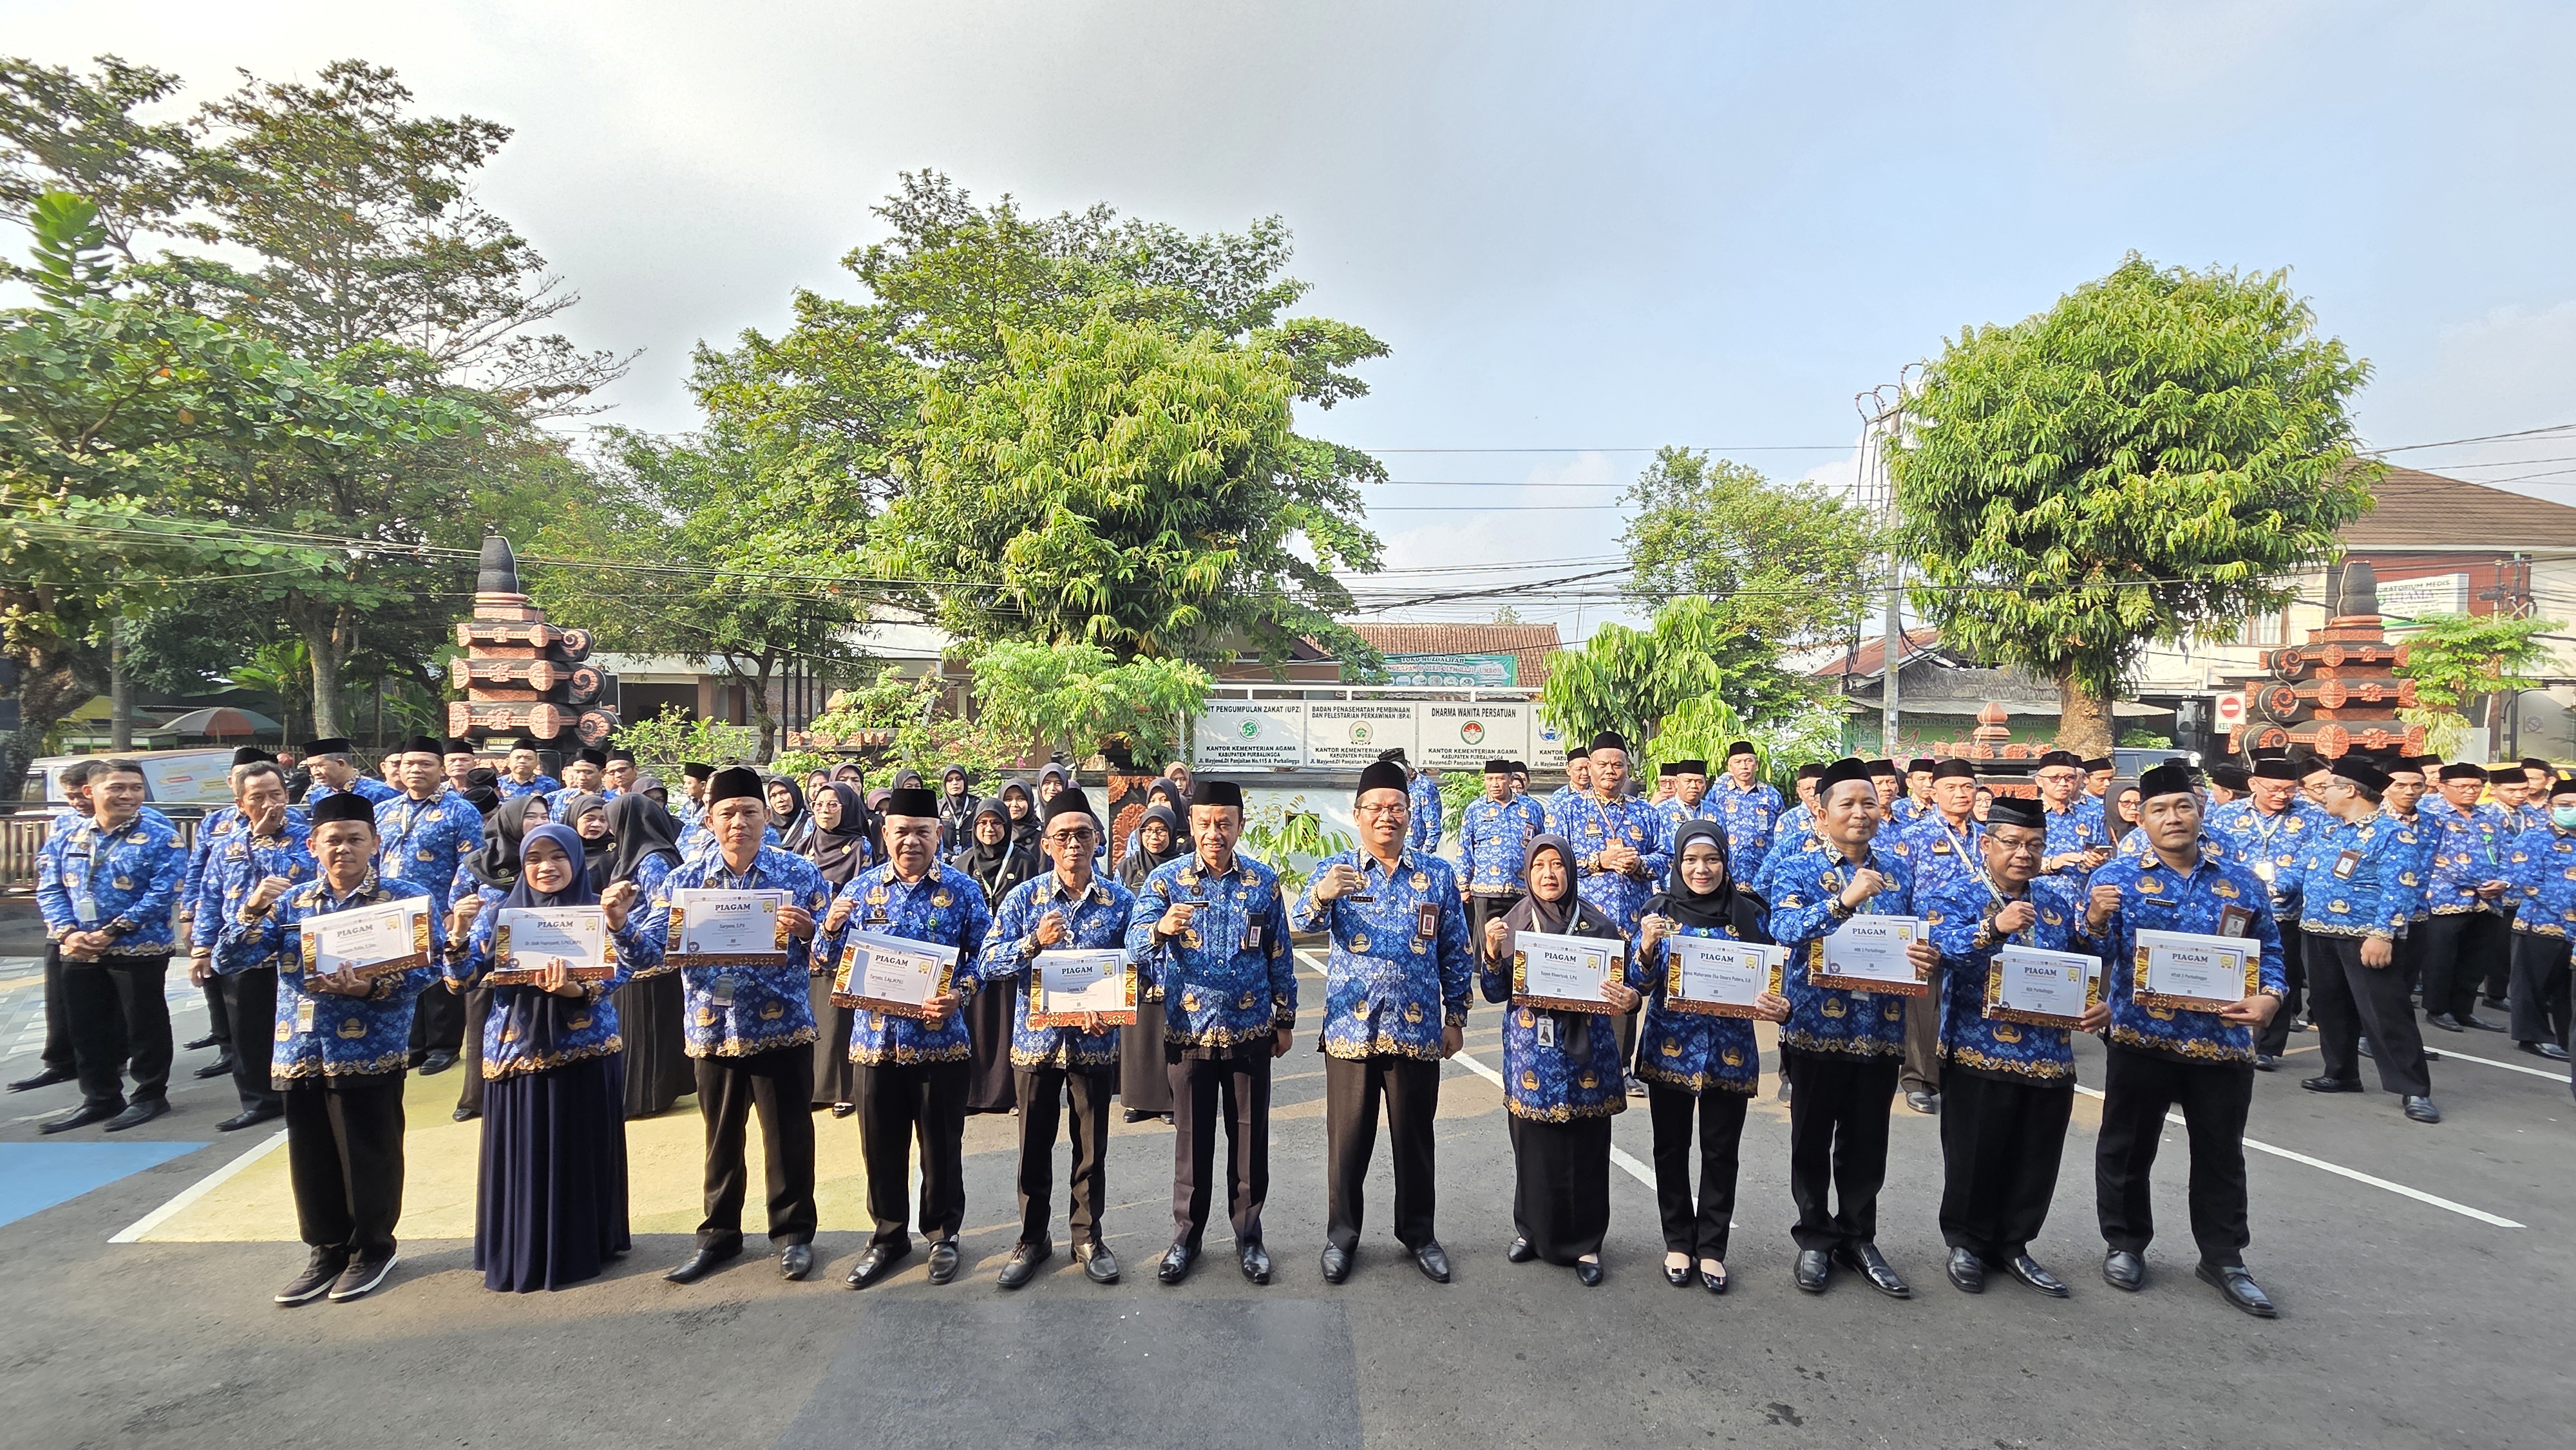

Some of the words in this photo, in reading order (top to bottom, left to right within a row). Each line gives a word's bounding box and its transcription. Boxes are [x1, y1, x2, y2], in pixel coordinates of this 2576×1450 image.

[2378, 583, 2423, 592] ORATORIUM
[1432, 708, 1455, 717] DHARMA
[1458, 708, 1480, 717] WANITA
[1482, 708, 1516, 717] PERSATUAN
[337, 925, 374, 937] PIAGAM
[875, 955, 909, 966] PIAGAM
[1544, 952, 1577, 962] PIAGAM
[1701, 953, 1734, 963] PIAGAM
[2172, 954, 2208, 963] PIAGAM
[2024, 967, 2057, 975] PIAGAM
